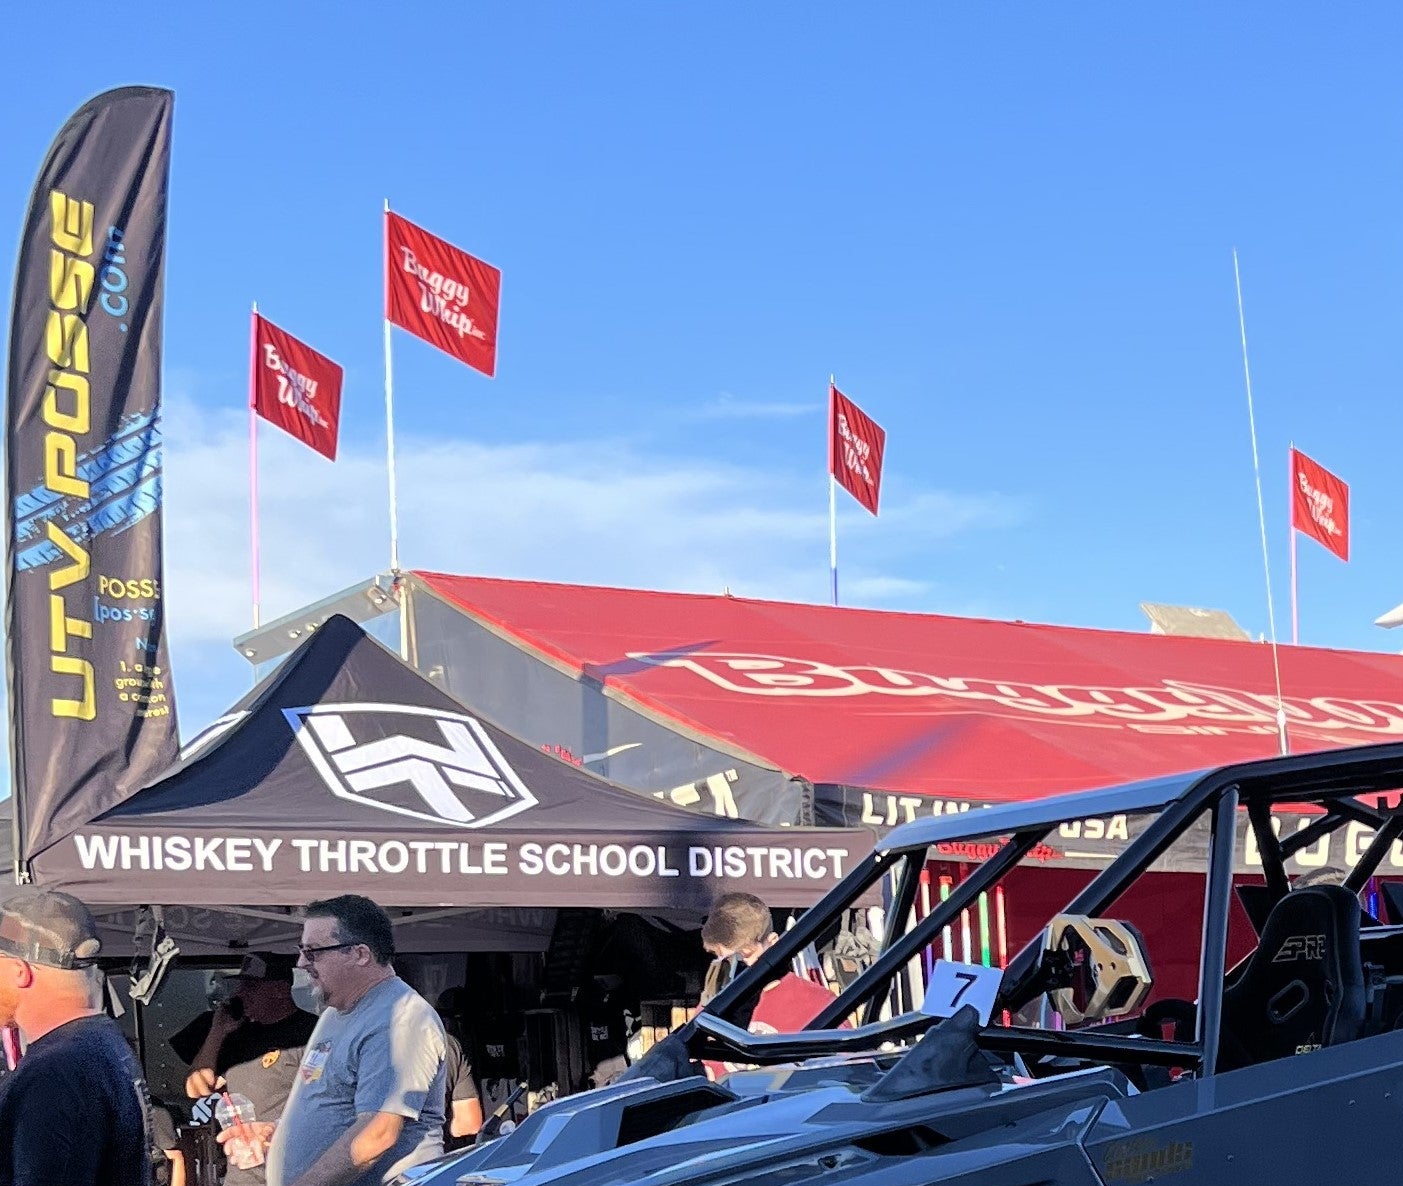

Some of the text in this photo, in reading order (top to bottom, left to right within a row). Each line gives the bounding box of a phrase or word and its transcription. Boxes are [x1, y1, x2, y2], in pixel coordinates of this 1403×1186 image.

[400, 244, 470, 307] Buggy
[418, 281, 473, 338] Whip
[42, 190, 97, 721] UTV POSSE
[861, 793, 922, 826] LIT
[75, 835, 849, 880] WHISKEY THROTTLE SCHOOL DISTRICT
[949, 971, 979, 1008] 7
